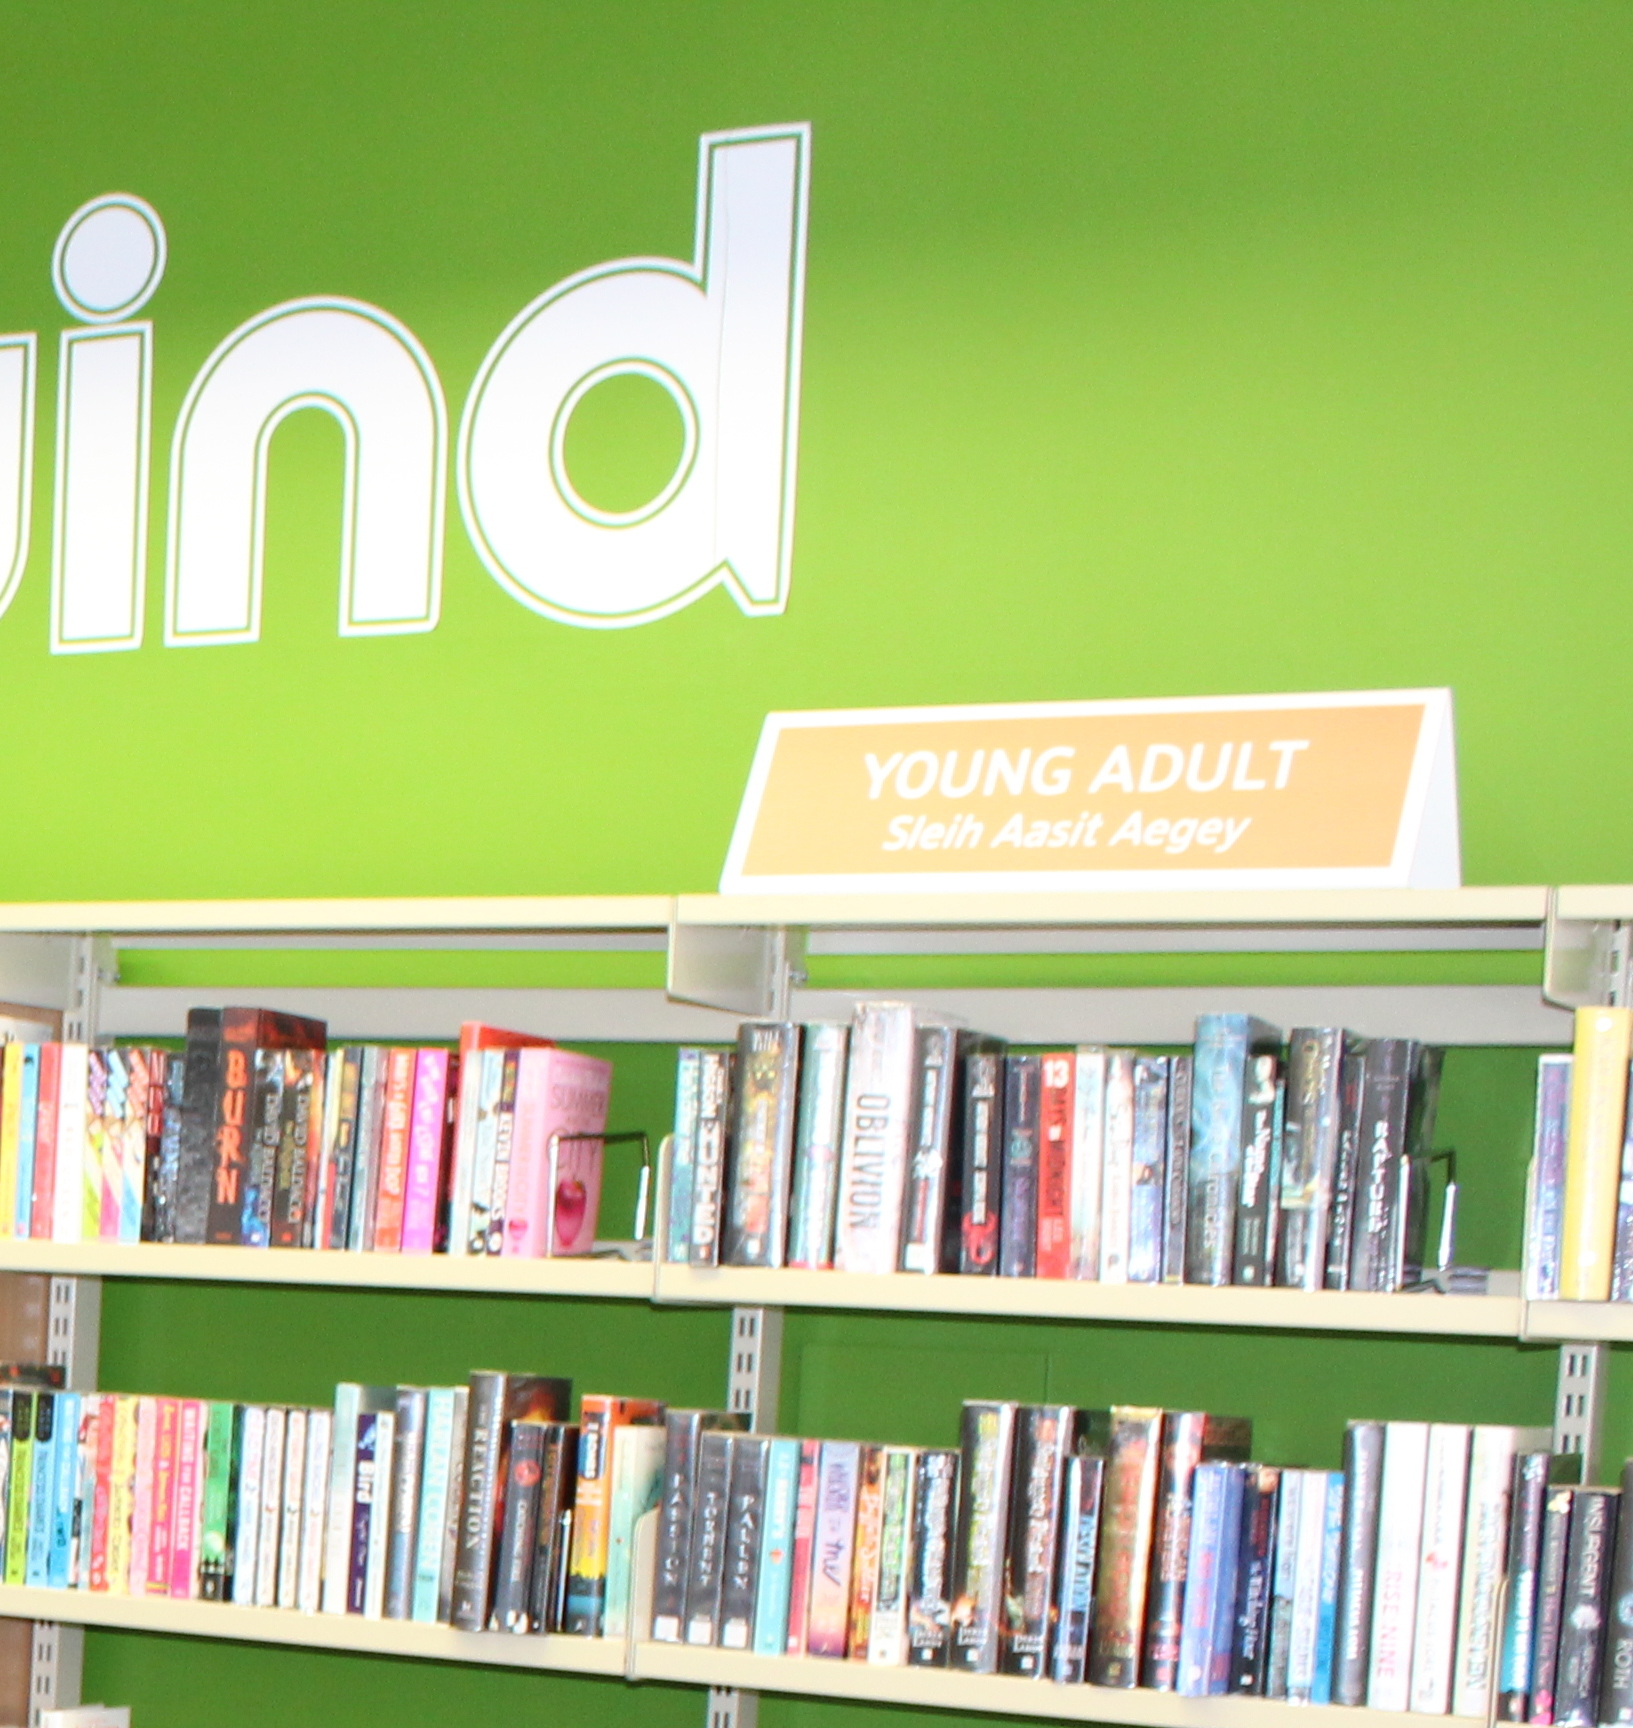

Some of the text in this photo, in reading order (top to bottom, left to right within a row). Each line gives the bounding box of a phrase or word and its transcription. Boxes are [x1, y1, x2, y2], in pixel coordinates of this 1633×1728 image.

[864, 739, 1312, 800] YOUNG ADULT
[882, 809, 1251, 854] Sleih Aasit Aegey
[217, 1046, 248, 1207] BURN
[849, 1094, 892, 1230] OBLIVION
[176, 1408, 197, 1550] WAITING CALLBACK
[356, 1460, 374, 1503] Bird
[465, 1427, 488, 1551] REACTION
[1579, 1496, 1605, 1597] INSURGENT
[1377, 1569, 1403, 1680] RISE NINE
[1613, 1638, 1632, 1690] ROTH
